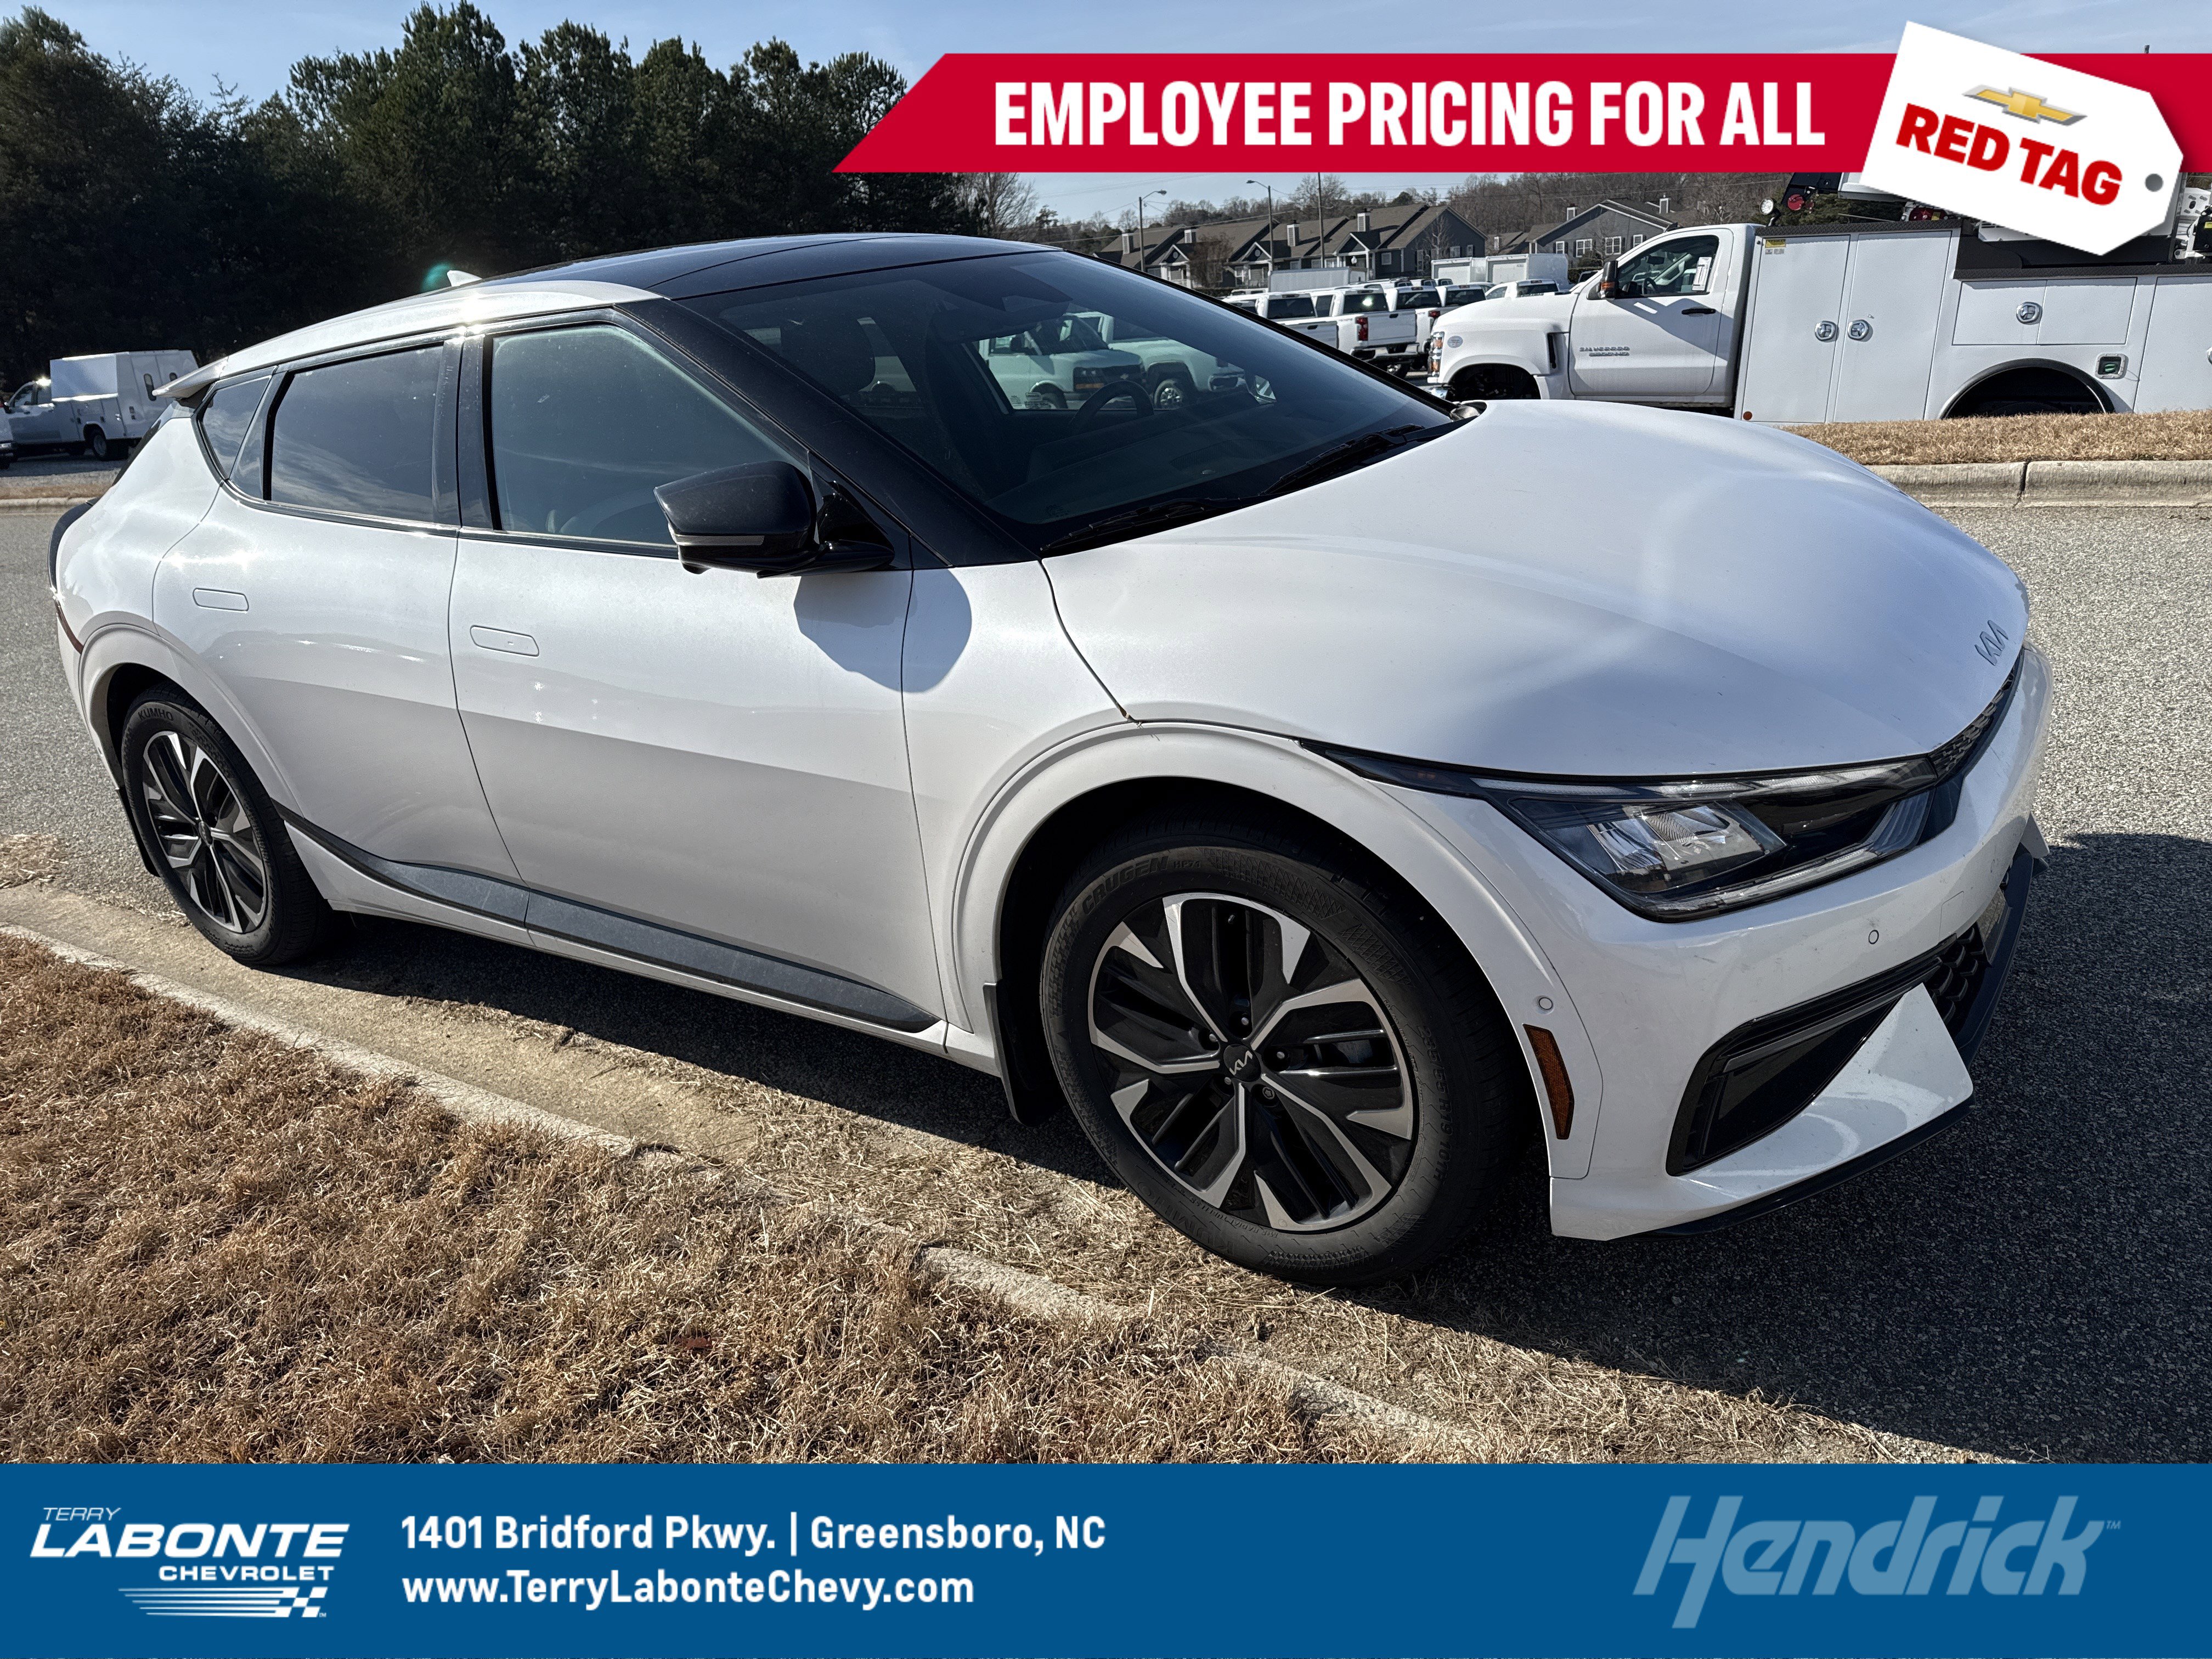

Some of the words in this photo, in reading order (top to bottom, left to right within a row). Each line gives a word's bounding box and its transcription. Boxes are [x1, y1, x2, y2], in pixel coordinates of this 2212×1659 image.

[138, 708, 174, 721] KUMHO
[1082, 855, 1170, 915] CRUGEN
[1229, 1050, 1253, 1076] KIA
[1416, 1025, 1449, 1094] 235/55
[1438, 1098, 1454, 1136] R19
[1137, 1181, 1234, 1256] KUMHO
